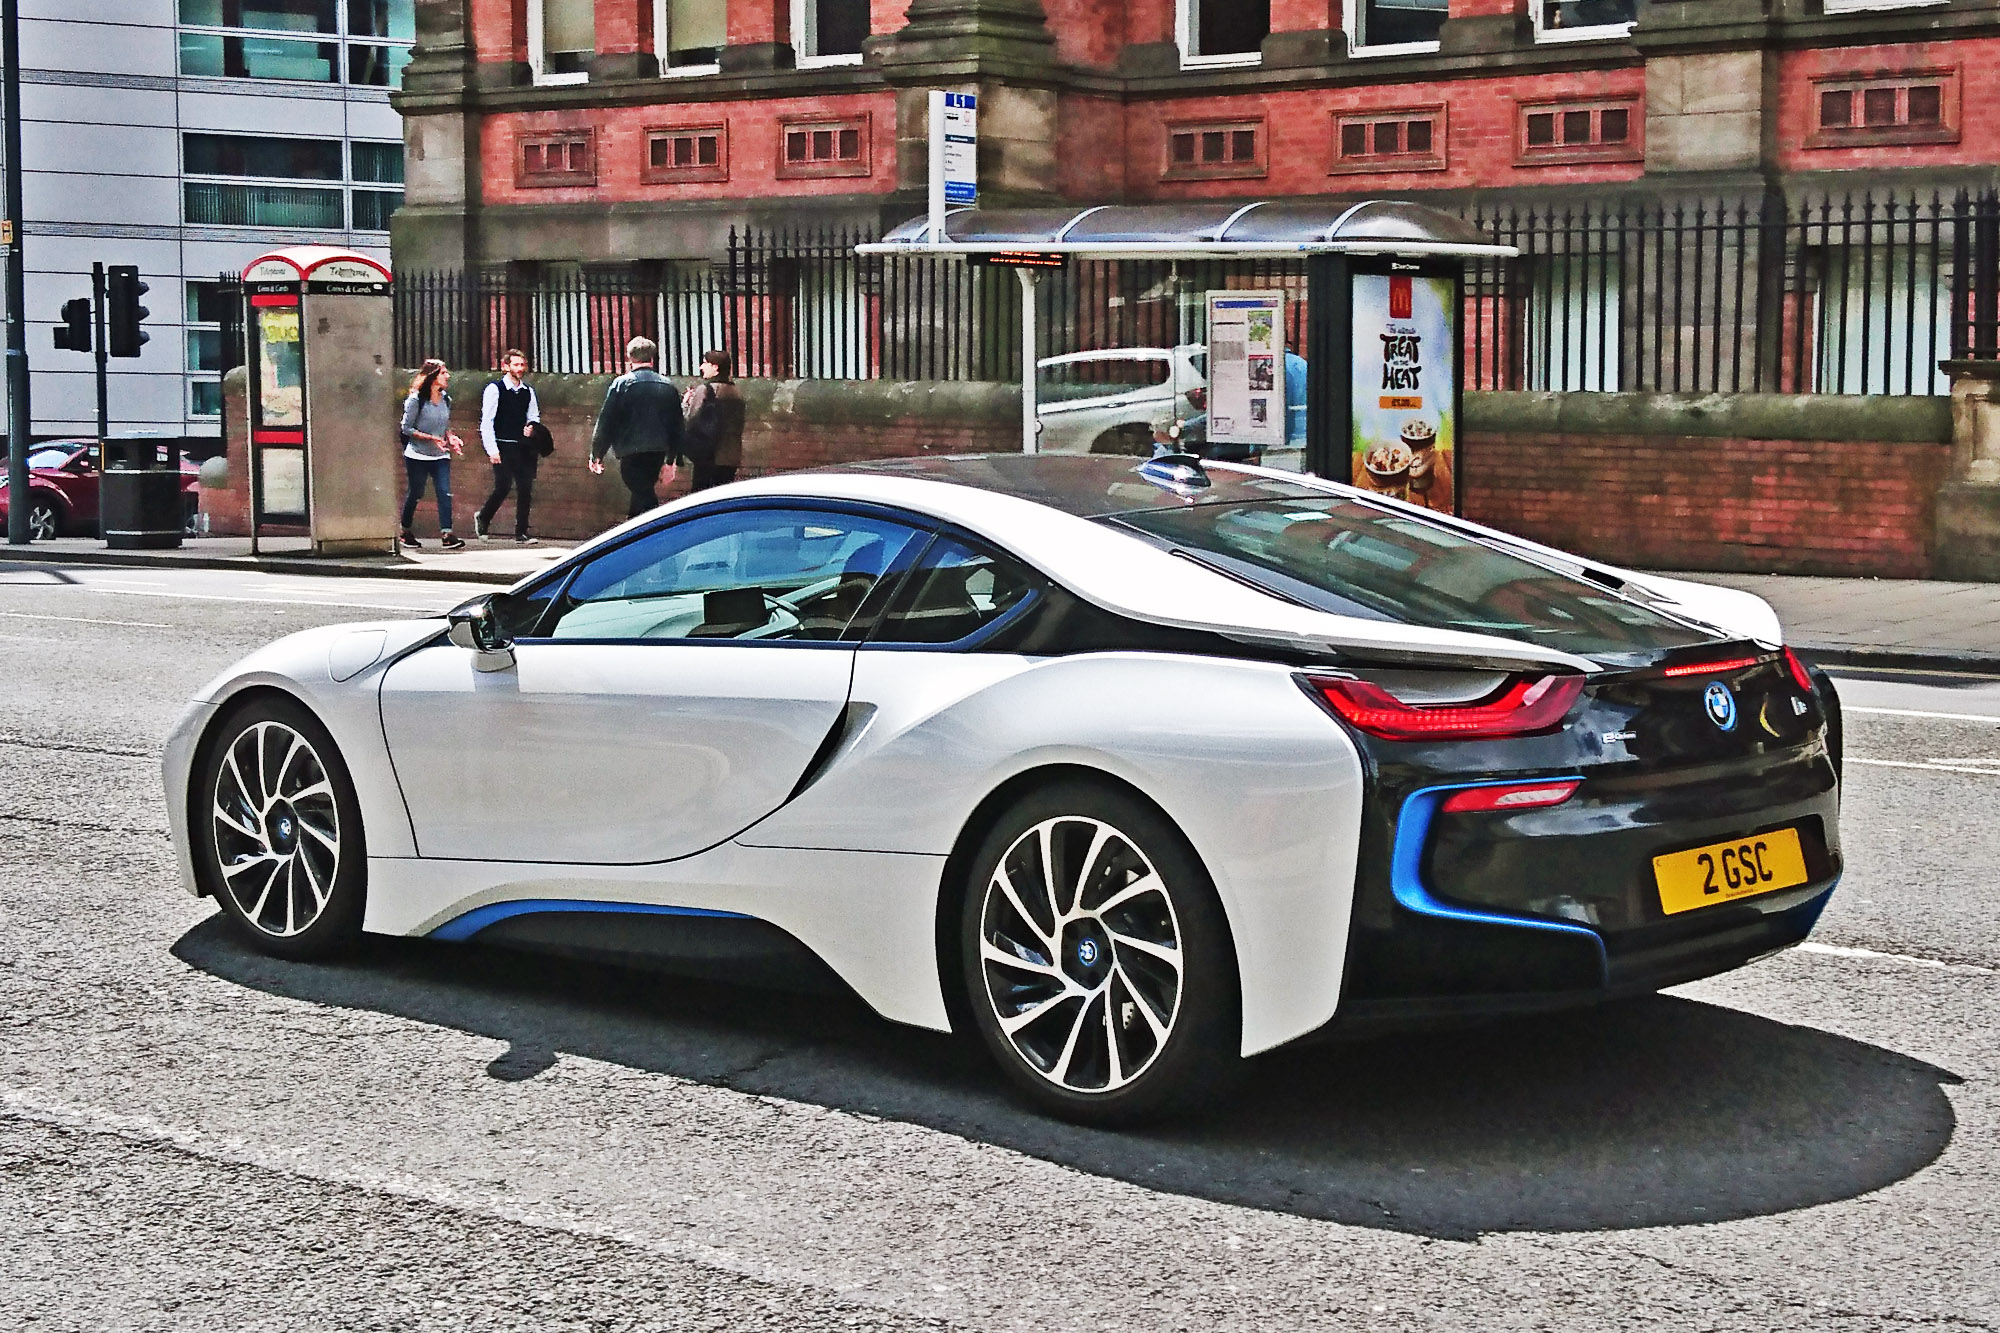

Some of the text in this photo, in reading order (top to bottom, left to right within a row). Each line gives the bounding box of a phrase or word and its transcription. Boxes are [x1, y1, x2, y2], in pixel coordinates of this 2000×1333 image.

[326, 284, 372, 293] Coins & Cards
[1380, 333, 1421, 363] TREAT
[1381, 363, 1422, 390] HEAT
[1697, 841, 1773, 895] 2 GSC
